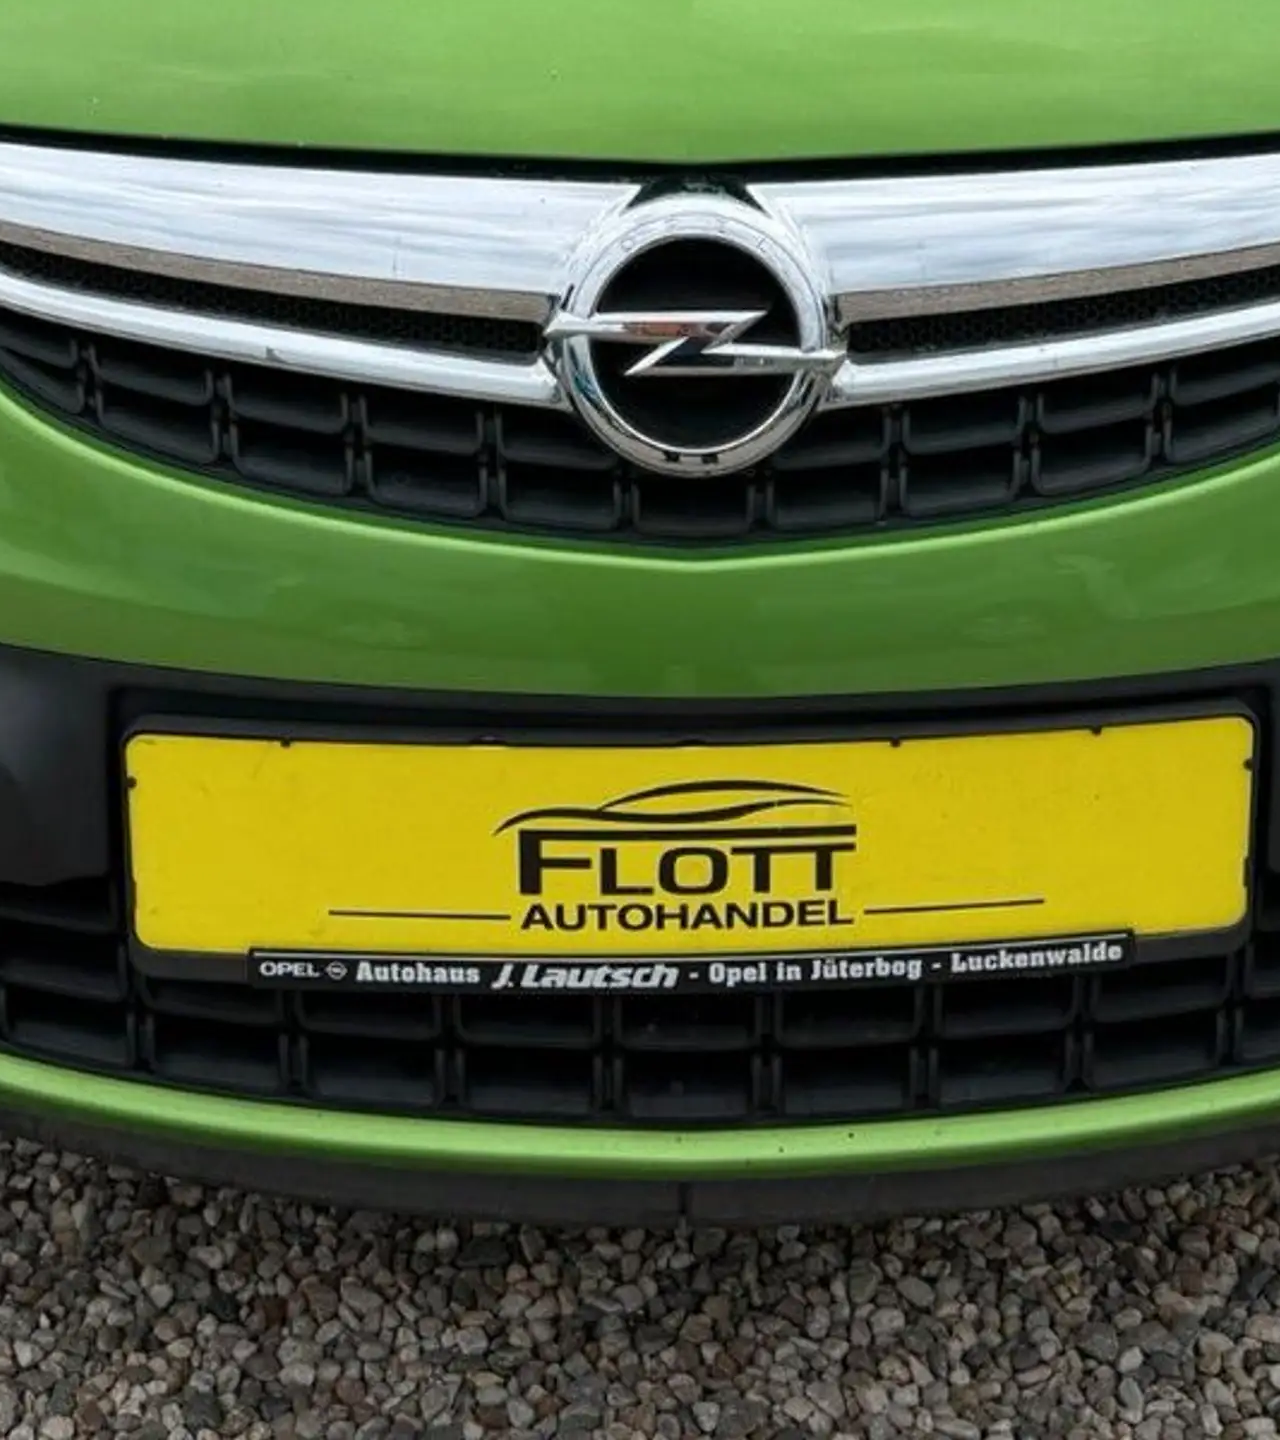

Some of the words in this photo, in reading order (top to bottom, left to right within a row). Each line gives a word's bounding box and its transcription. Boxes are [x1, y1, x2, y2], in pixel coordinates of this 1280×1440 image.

[518, 824, 857, 895] FLOTT
[520, 900, 854, 931] AUTOHANDEL
[259, 961, 320, 978] OPEL
[356, 961, 481, 983] Autohaus
[491, 963, 514, 990] J.
[520, 963, 680, 989] Lautsch
[709, 962, 767, 986] Opel
[776, 961, 802, 981] in
[811, 957, 922, 980] Jüterbog
[951, 941, 1122, 973] Luckenwalde
